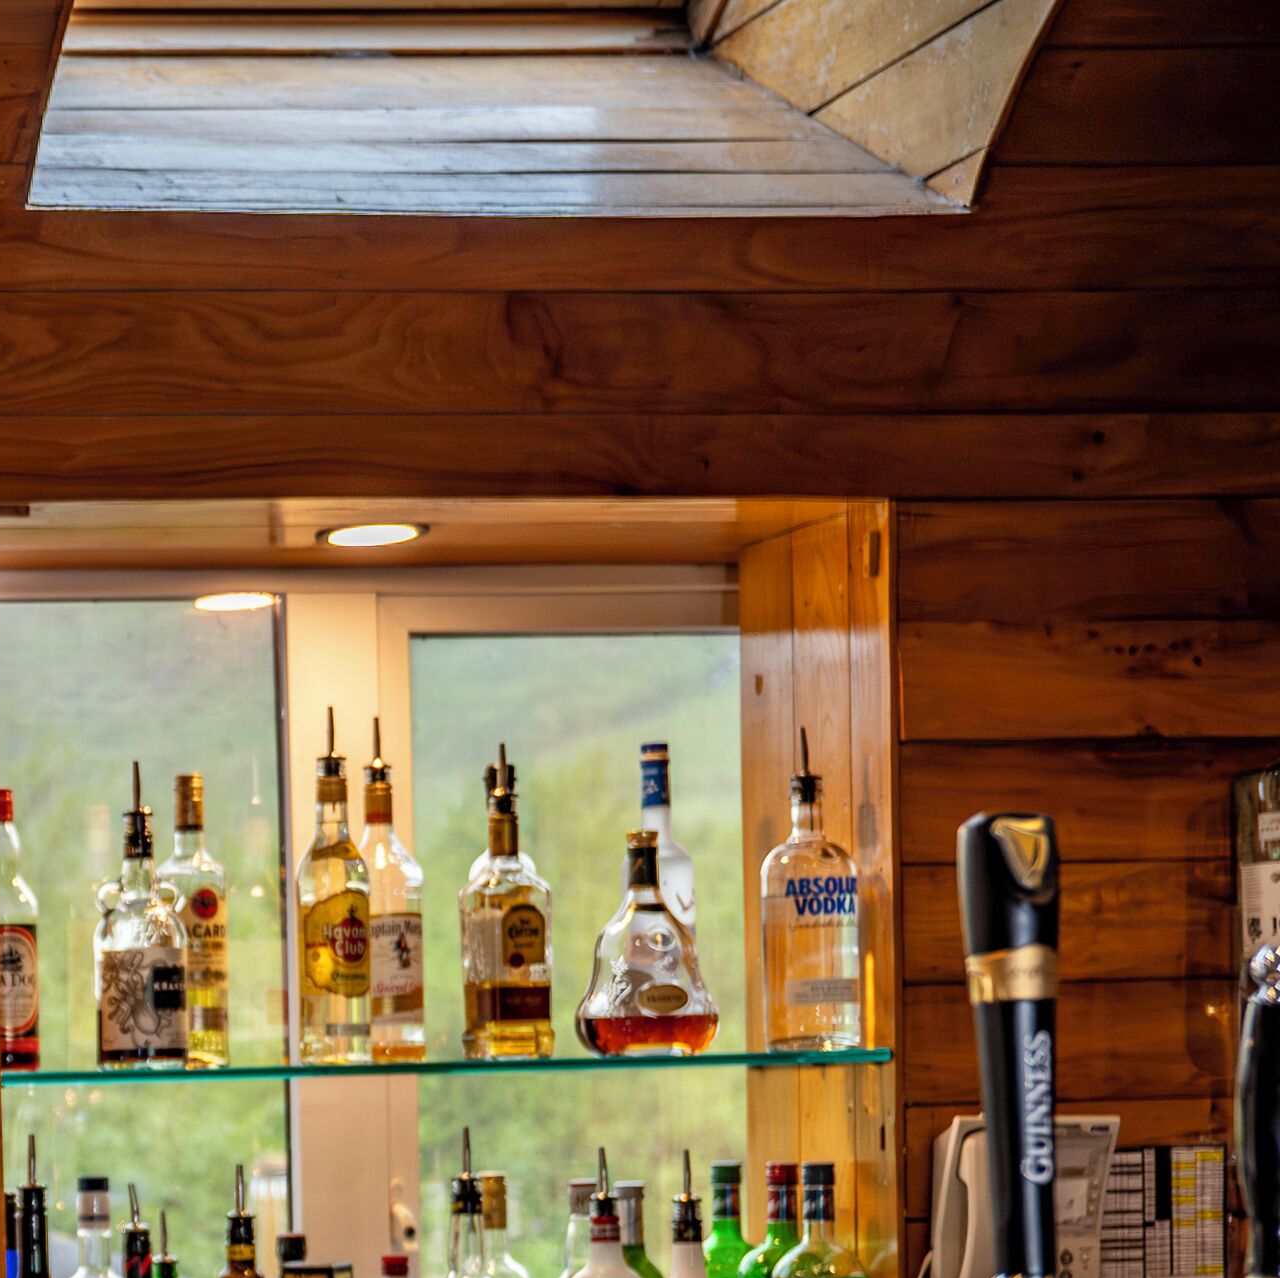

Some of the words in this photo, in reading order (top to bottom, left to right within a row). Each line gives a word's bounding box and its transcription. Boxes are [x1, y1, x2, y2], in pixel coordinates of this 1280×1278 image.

[795, 897, 856, 916] VODKA
[335, 941, 365, 957] Club
[1020, 1030, 1054, 1184] GUINNESS
